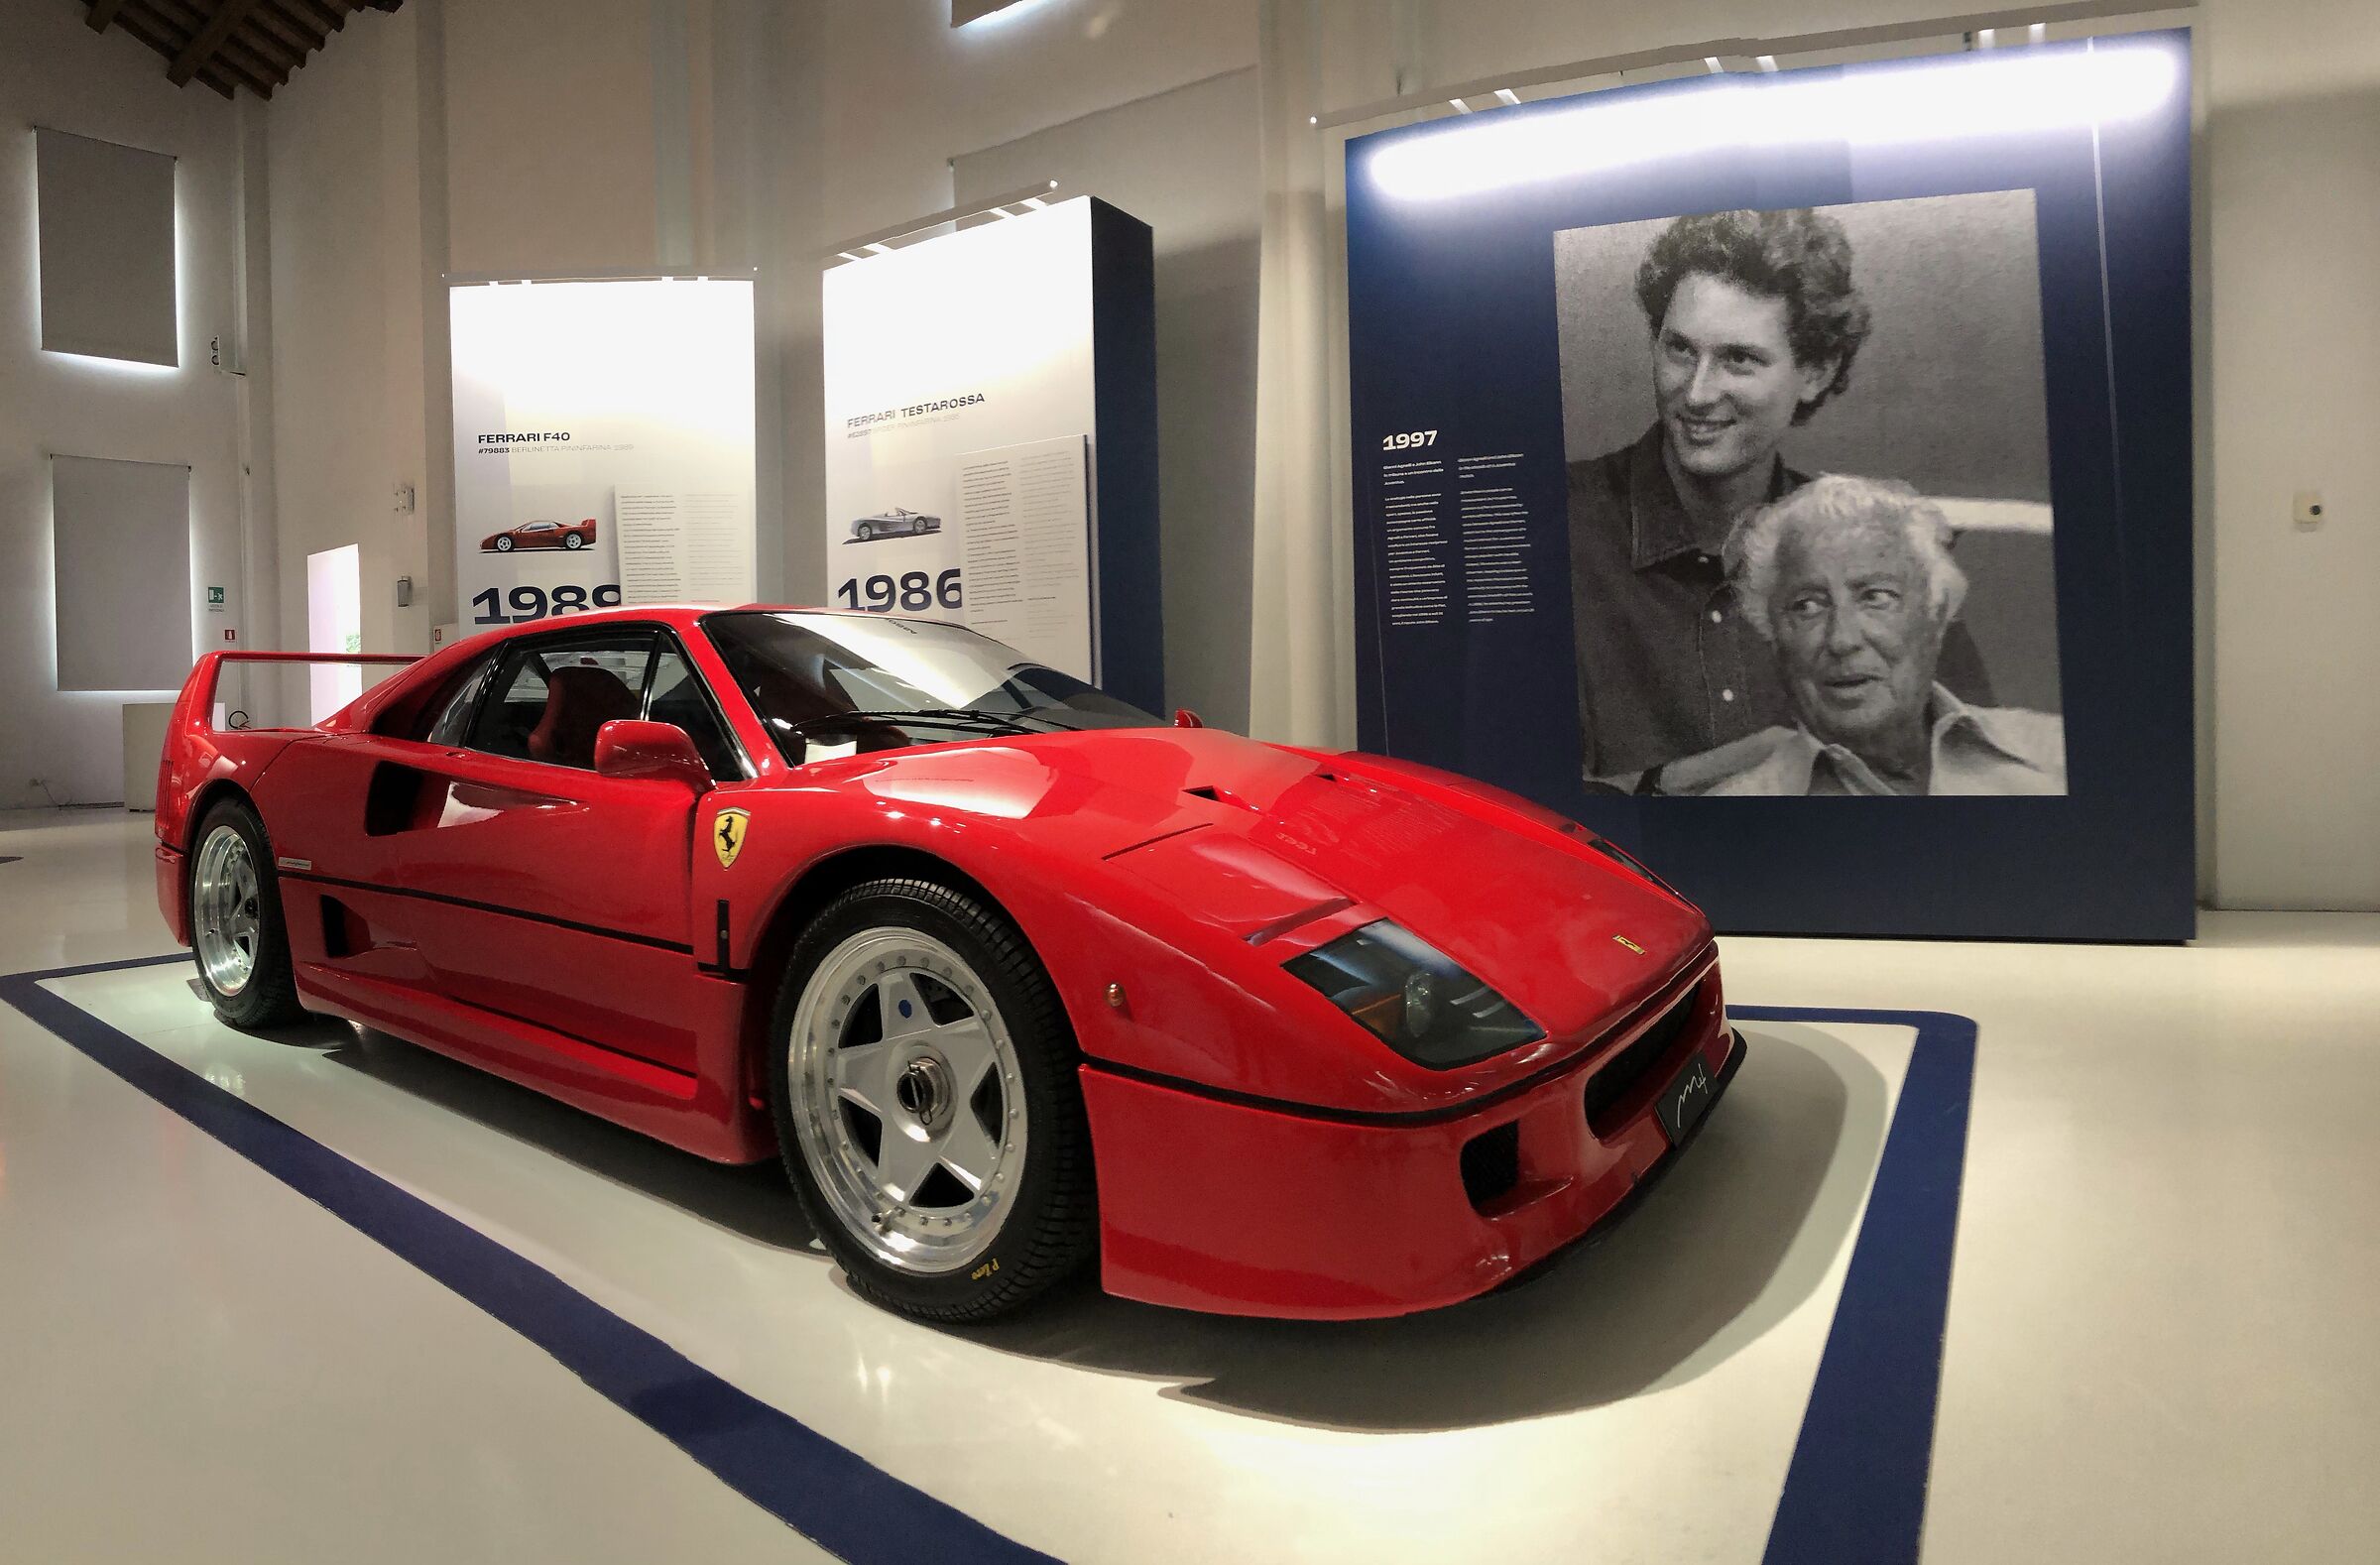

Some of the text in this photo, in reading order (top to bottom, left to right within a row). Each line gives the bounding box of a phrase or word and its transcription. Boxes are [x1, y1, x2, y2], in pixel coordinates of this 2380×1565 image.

[847, 393, 986, 428] FERRARI TESTAROSSA
[478, 431, 570, 444] FERRARI F40
[1382, 429, 1438, 451] 1997
[838, 567, 962, 613] 1986
